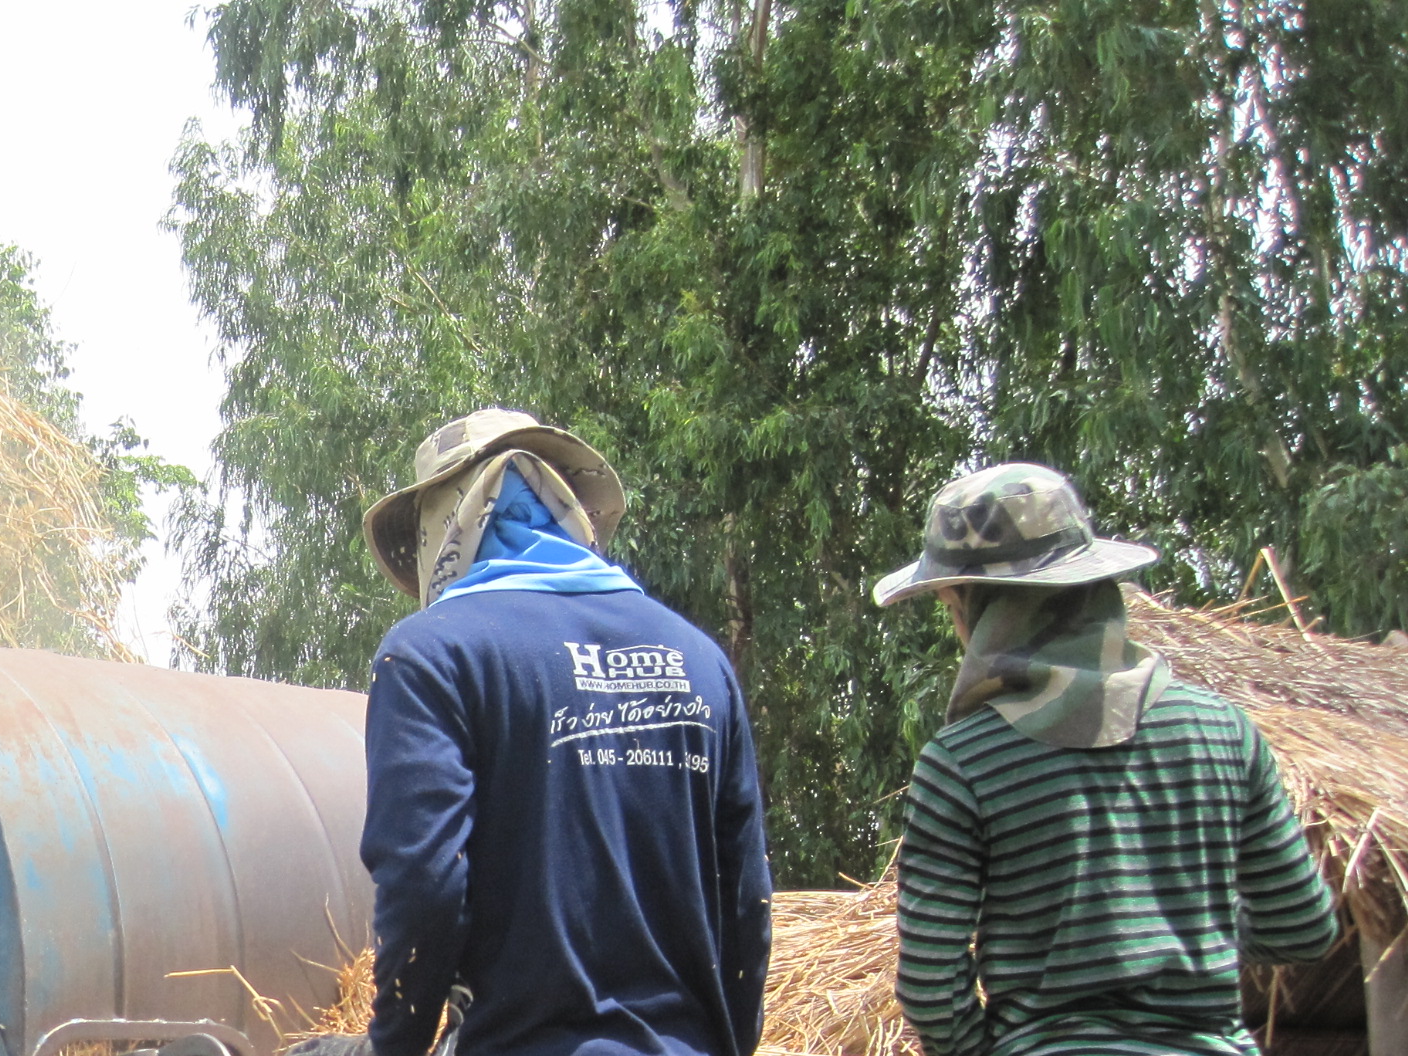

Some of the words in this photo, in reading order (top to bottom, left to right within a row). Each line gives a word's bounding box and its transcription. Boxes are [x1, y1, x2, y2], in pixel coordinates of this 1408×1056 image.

[563, 641, 684, 678] Home
[608, 666, 686, 678] HUB
[578, 750, 596, 766] Tel.
[597, 749, 616, 766] 045
[626, 749, 674, 766] 206111
